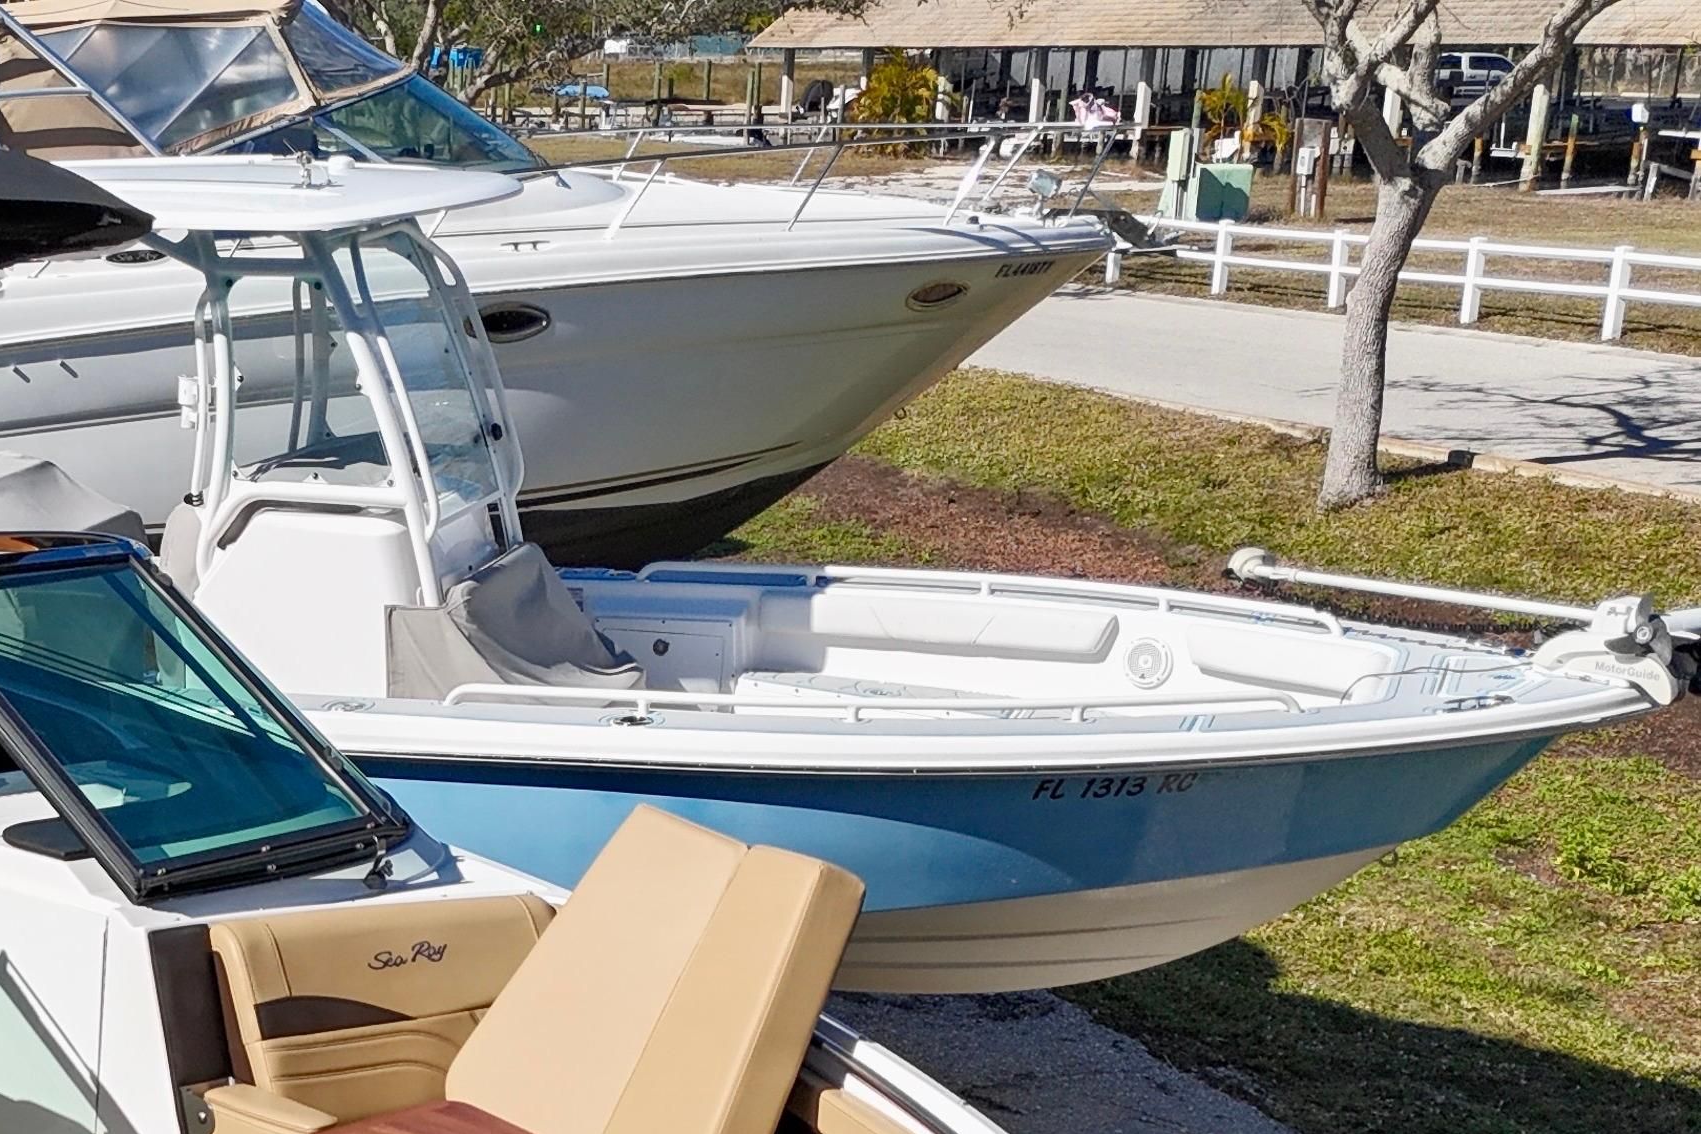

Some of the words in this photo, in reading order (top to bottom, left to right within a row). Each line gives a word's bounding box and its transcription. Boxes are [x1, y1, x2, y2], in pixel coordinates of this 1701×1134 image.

[1594, 660, 1661, 681] MotorGuide
[1032, 778, 1066, 801] FL
[1080, 776, 1148, 799] 1313
[1156, 772, 1199, 795] RC
[367, 950, 408, 971] Sea
[410, 940, 448, 963] Ray
